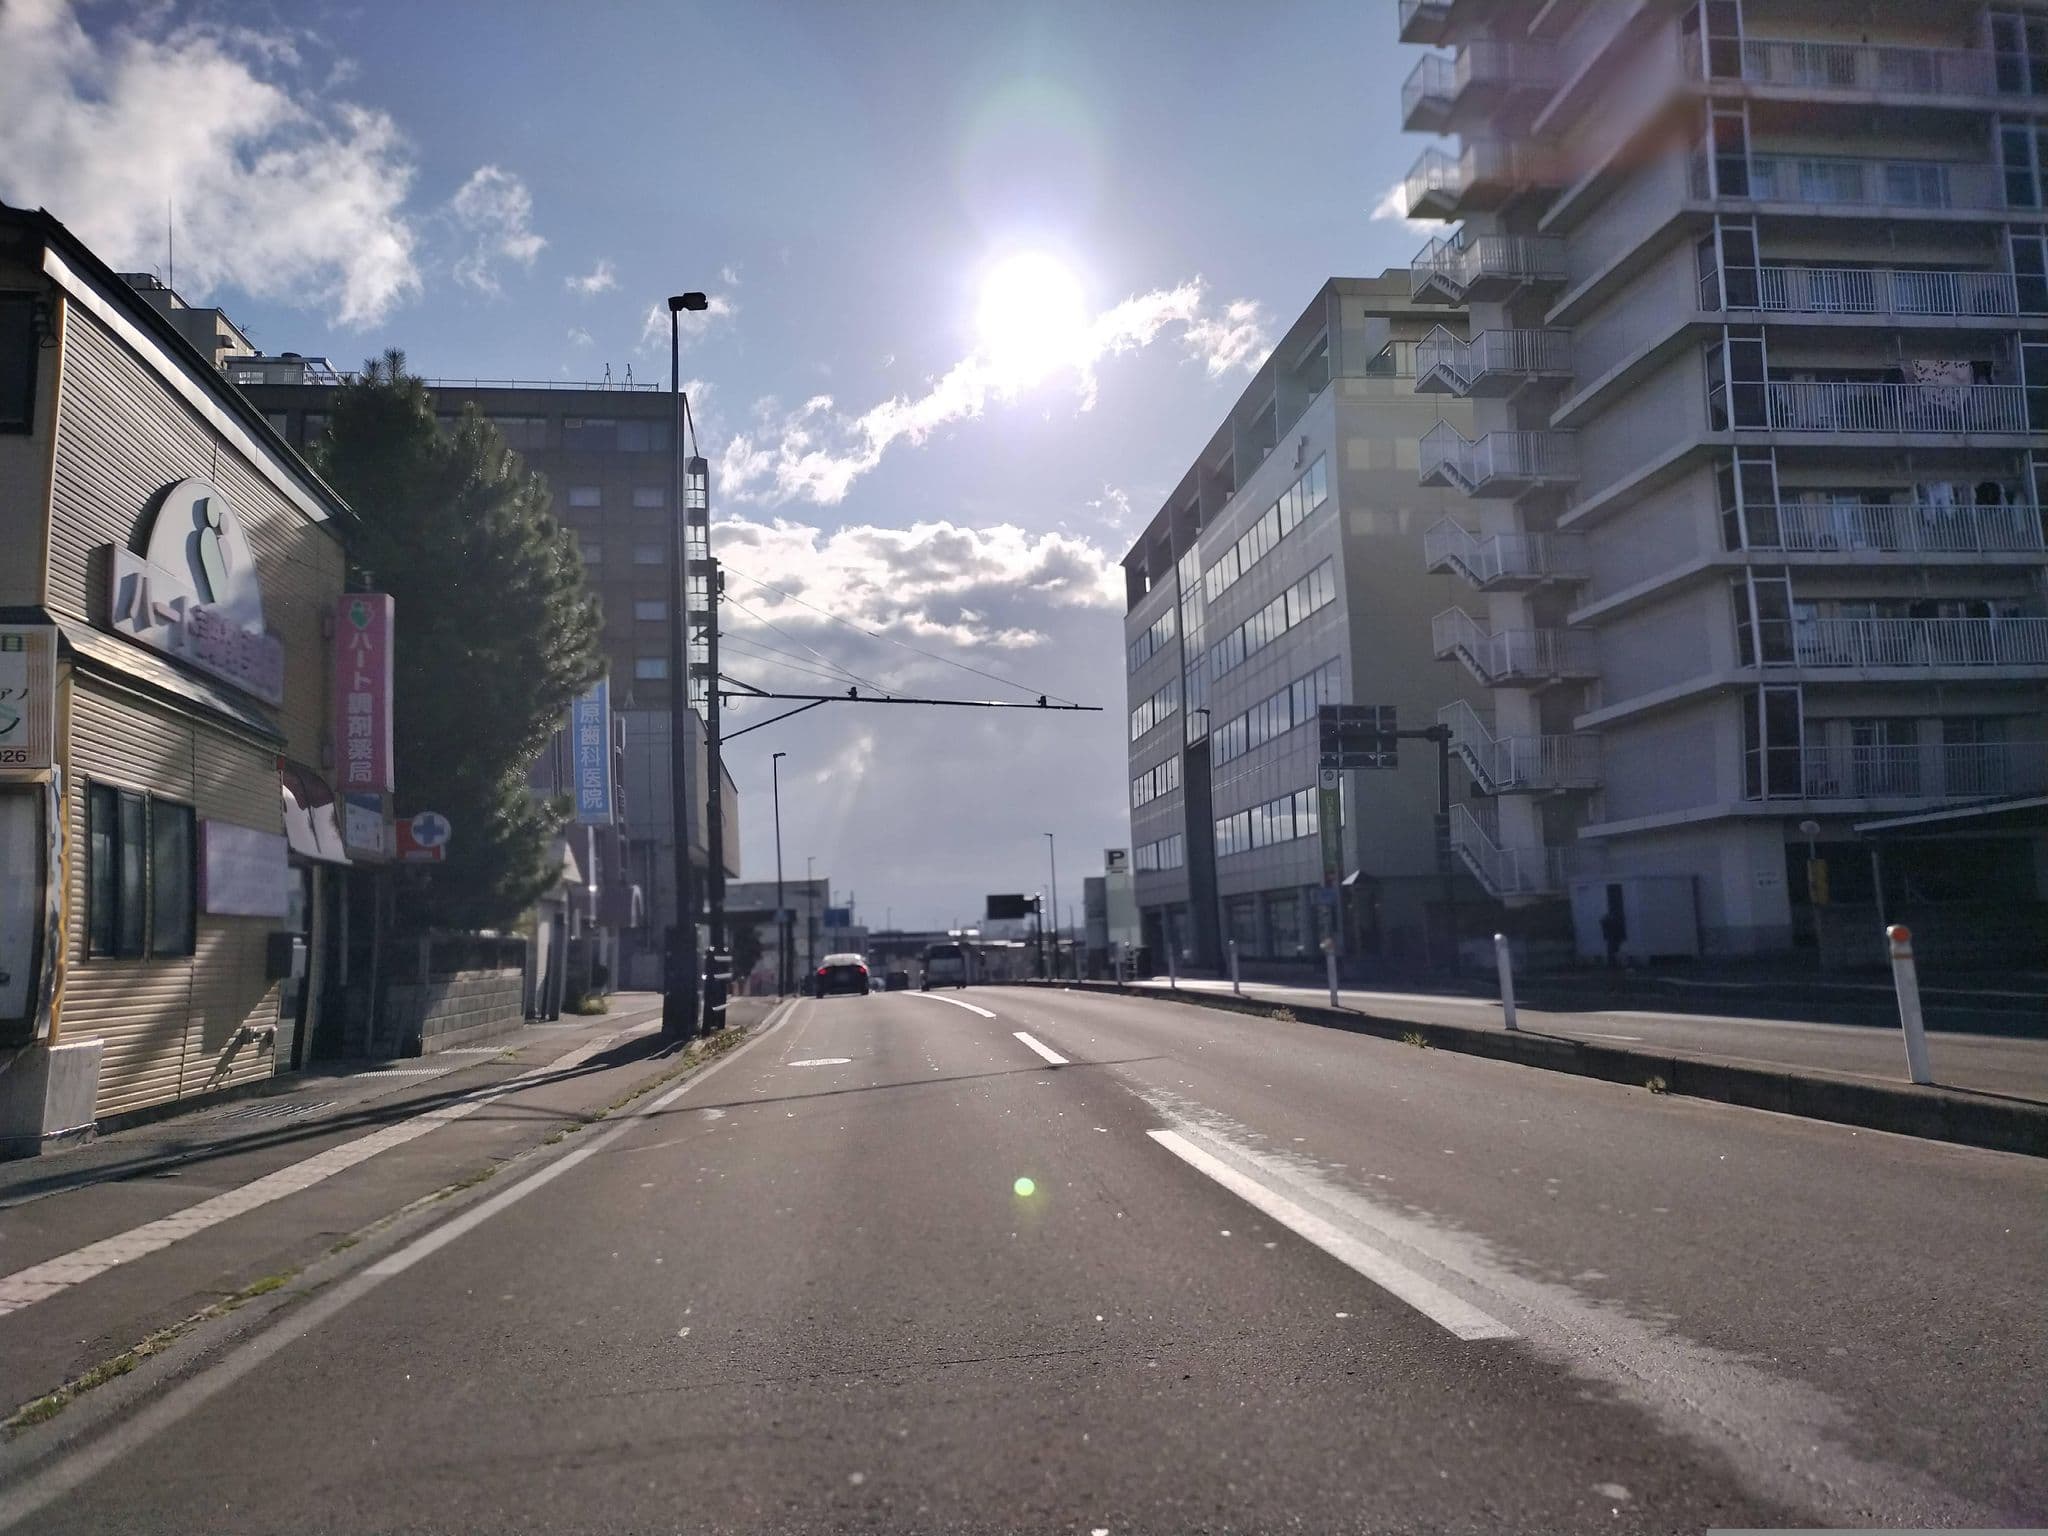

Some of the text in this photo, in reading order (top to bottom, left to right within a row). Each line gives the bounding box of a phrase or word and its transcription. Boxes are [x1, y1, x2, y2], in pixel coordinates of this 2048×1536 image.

[347, 632, 373, 784] ハート調剤薬局
[1108, 850, 1125, 865] P
